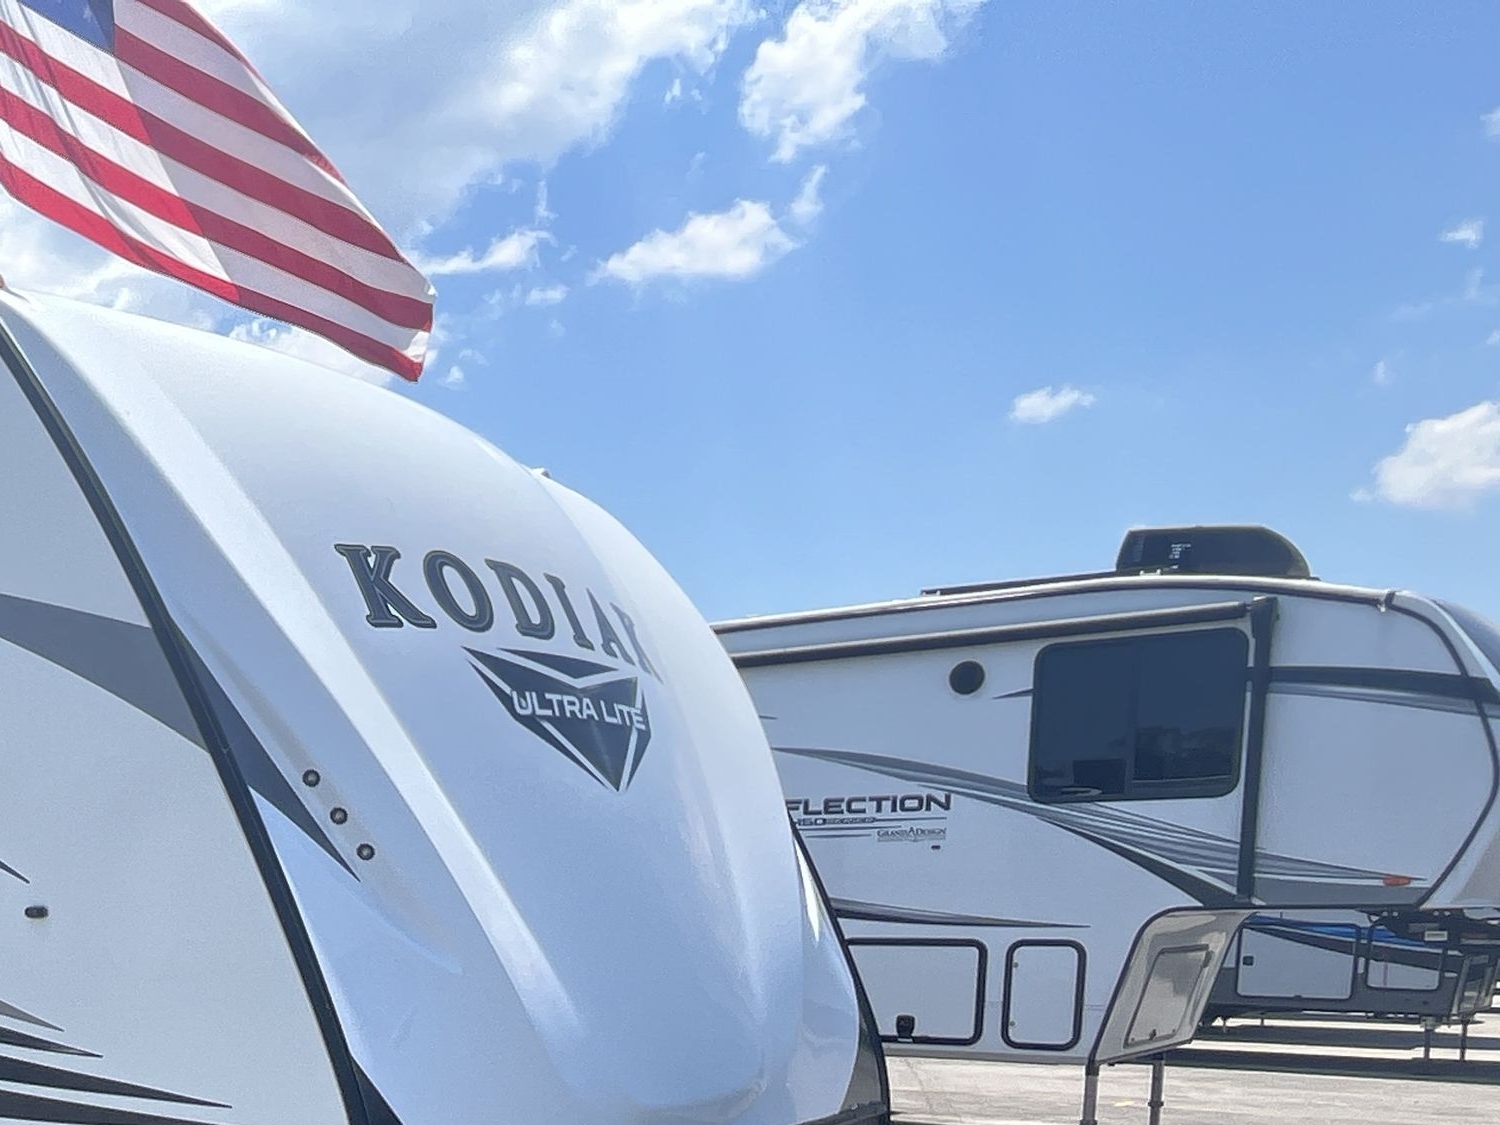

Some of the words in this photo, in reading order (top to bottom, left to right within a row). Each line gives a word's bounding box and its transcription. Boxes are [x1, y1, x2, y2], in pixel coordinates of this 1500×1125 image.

[334, 543, 664, 684] KODIAK
[510, 689, 600, 722] ULTRA
[601, 700, 647, 731] LITE
